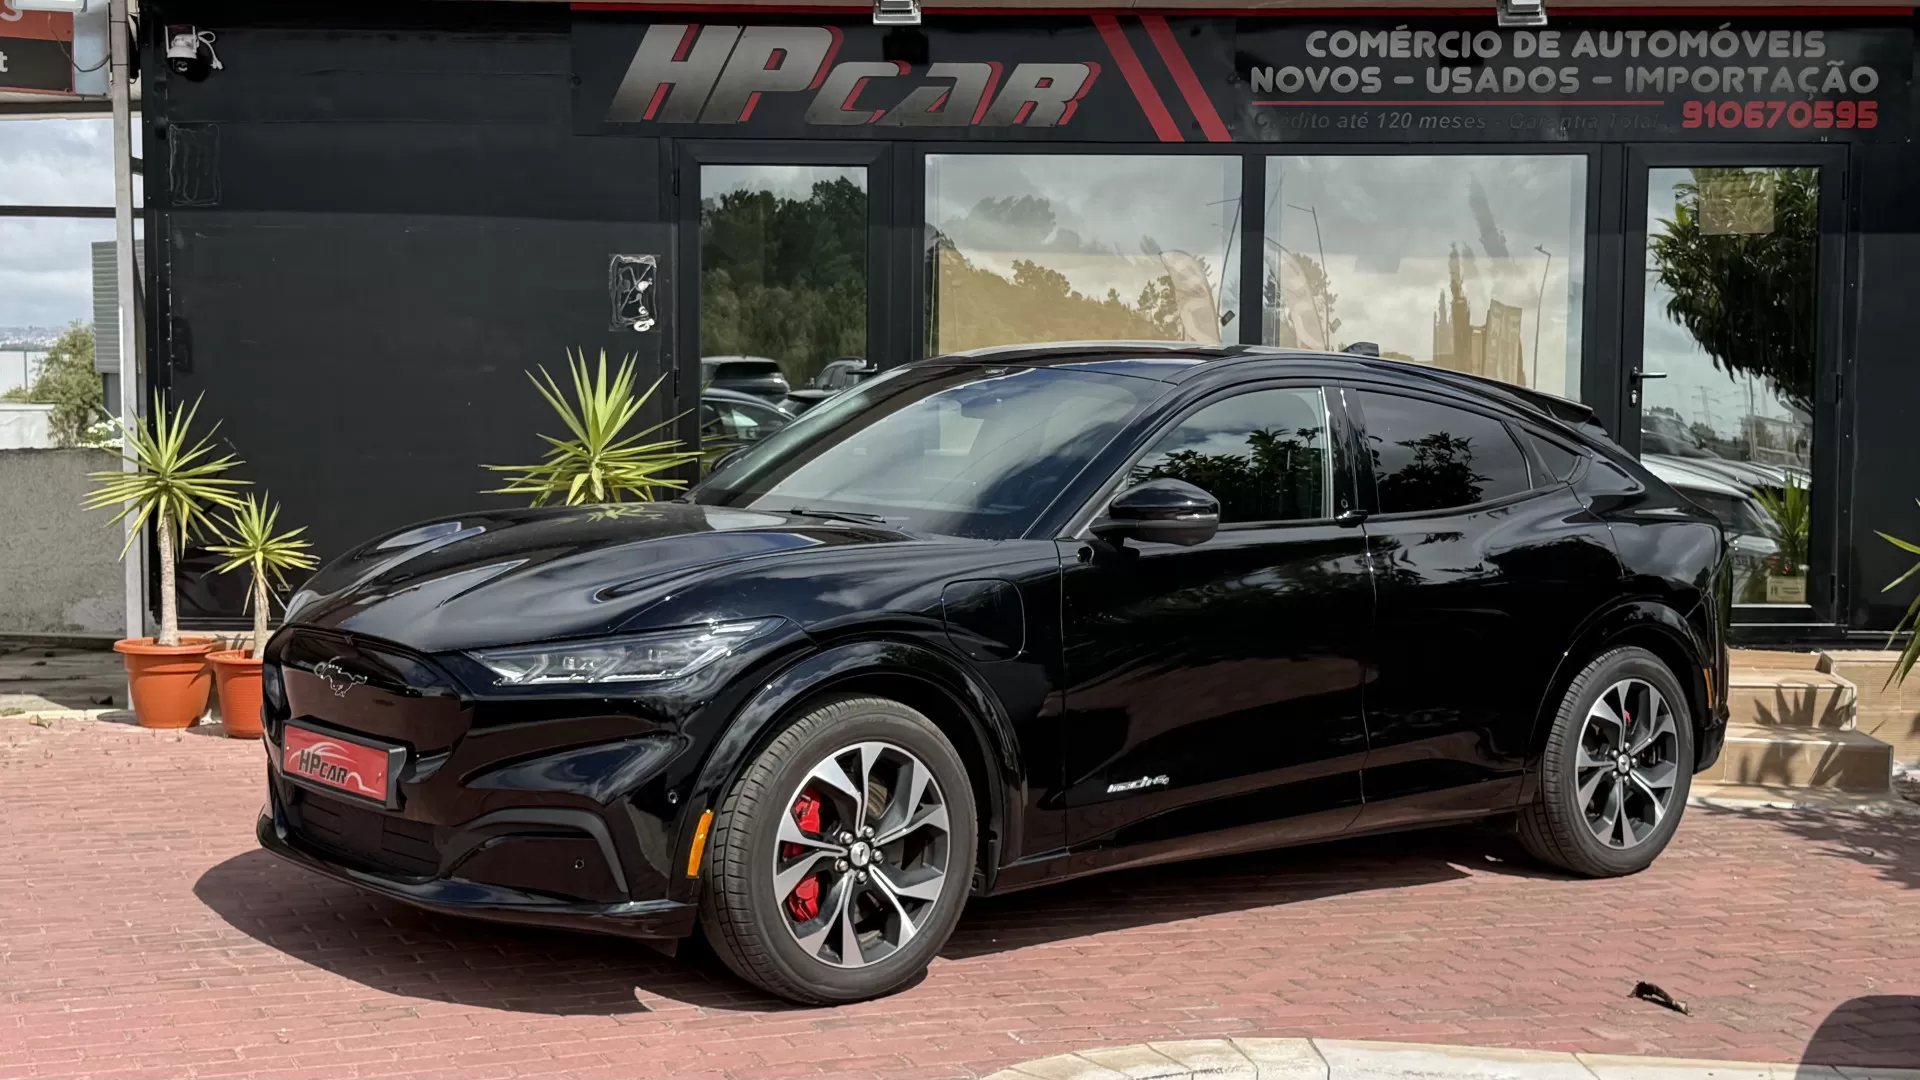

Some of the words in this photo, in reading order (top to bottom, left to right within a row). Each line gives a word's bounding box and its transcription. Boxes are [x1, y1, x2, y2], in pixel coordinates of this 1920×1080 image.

[1306, 25, 1502, 59] COMÉRCIO
[1514, 30, 1560, 59] DE
[1572, 23, 1826, 59] AUTOMÓVEIS
[1251, 66, 1381, 94] NOVOS
[1427, 66, 1579, 94] USADOS
[1626, 61, 1879, 100] IMPORTAÇÃO
[1255, 112, 1330, 129] Cédito
[1337, 112, 1369, 129] até
[1378, 112, 1412, 129] 120
[1419, 115, 1487, 129] meses
[1683, 101, 1878, 129] 910670595
[298, 749, 349, 784] HPCAR
